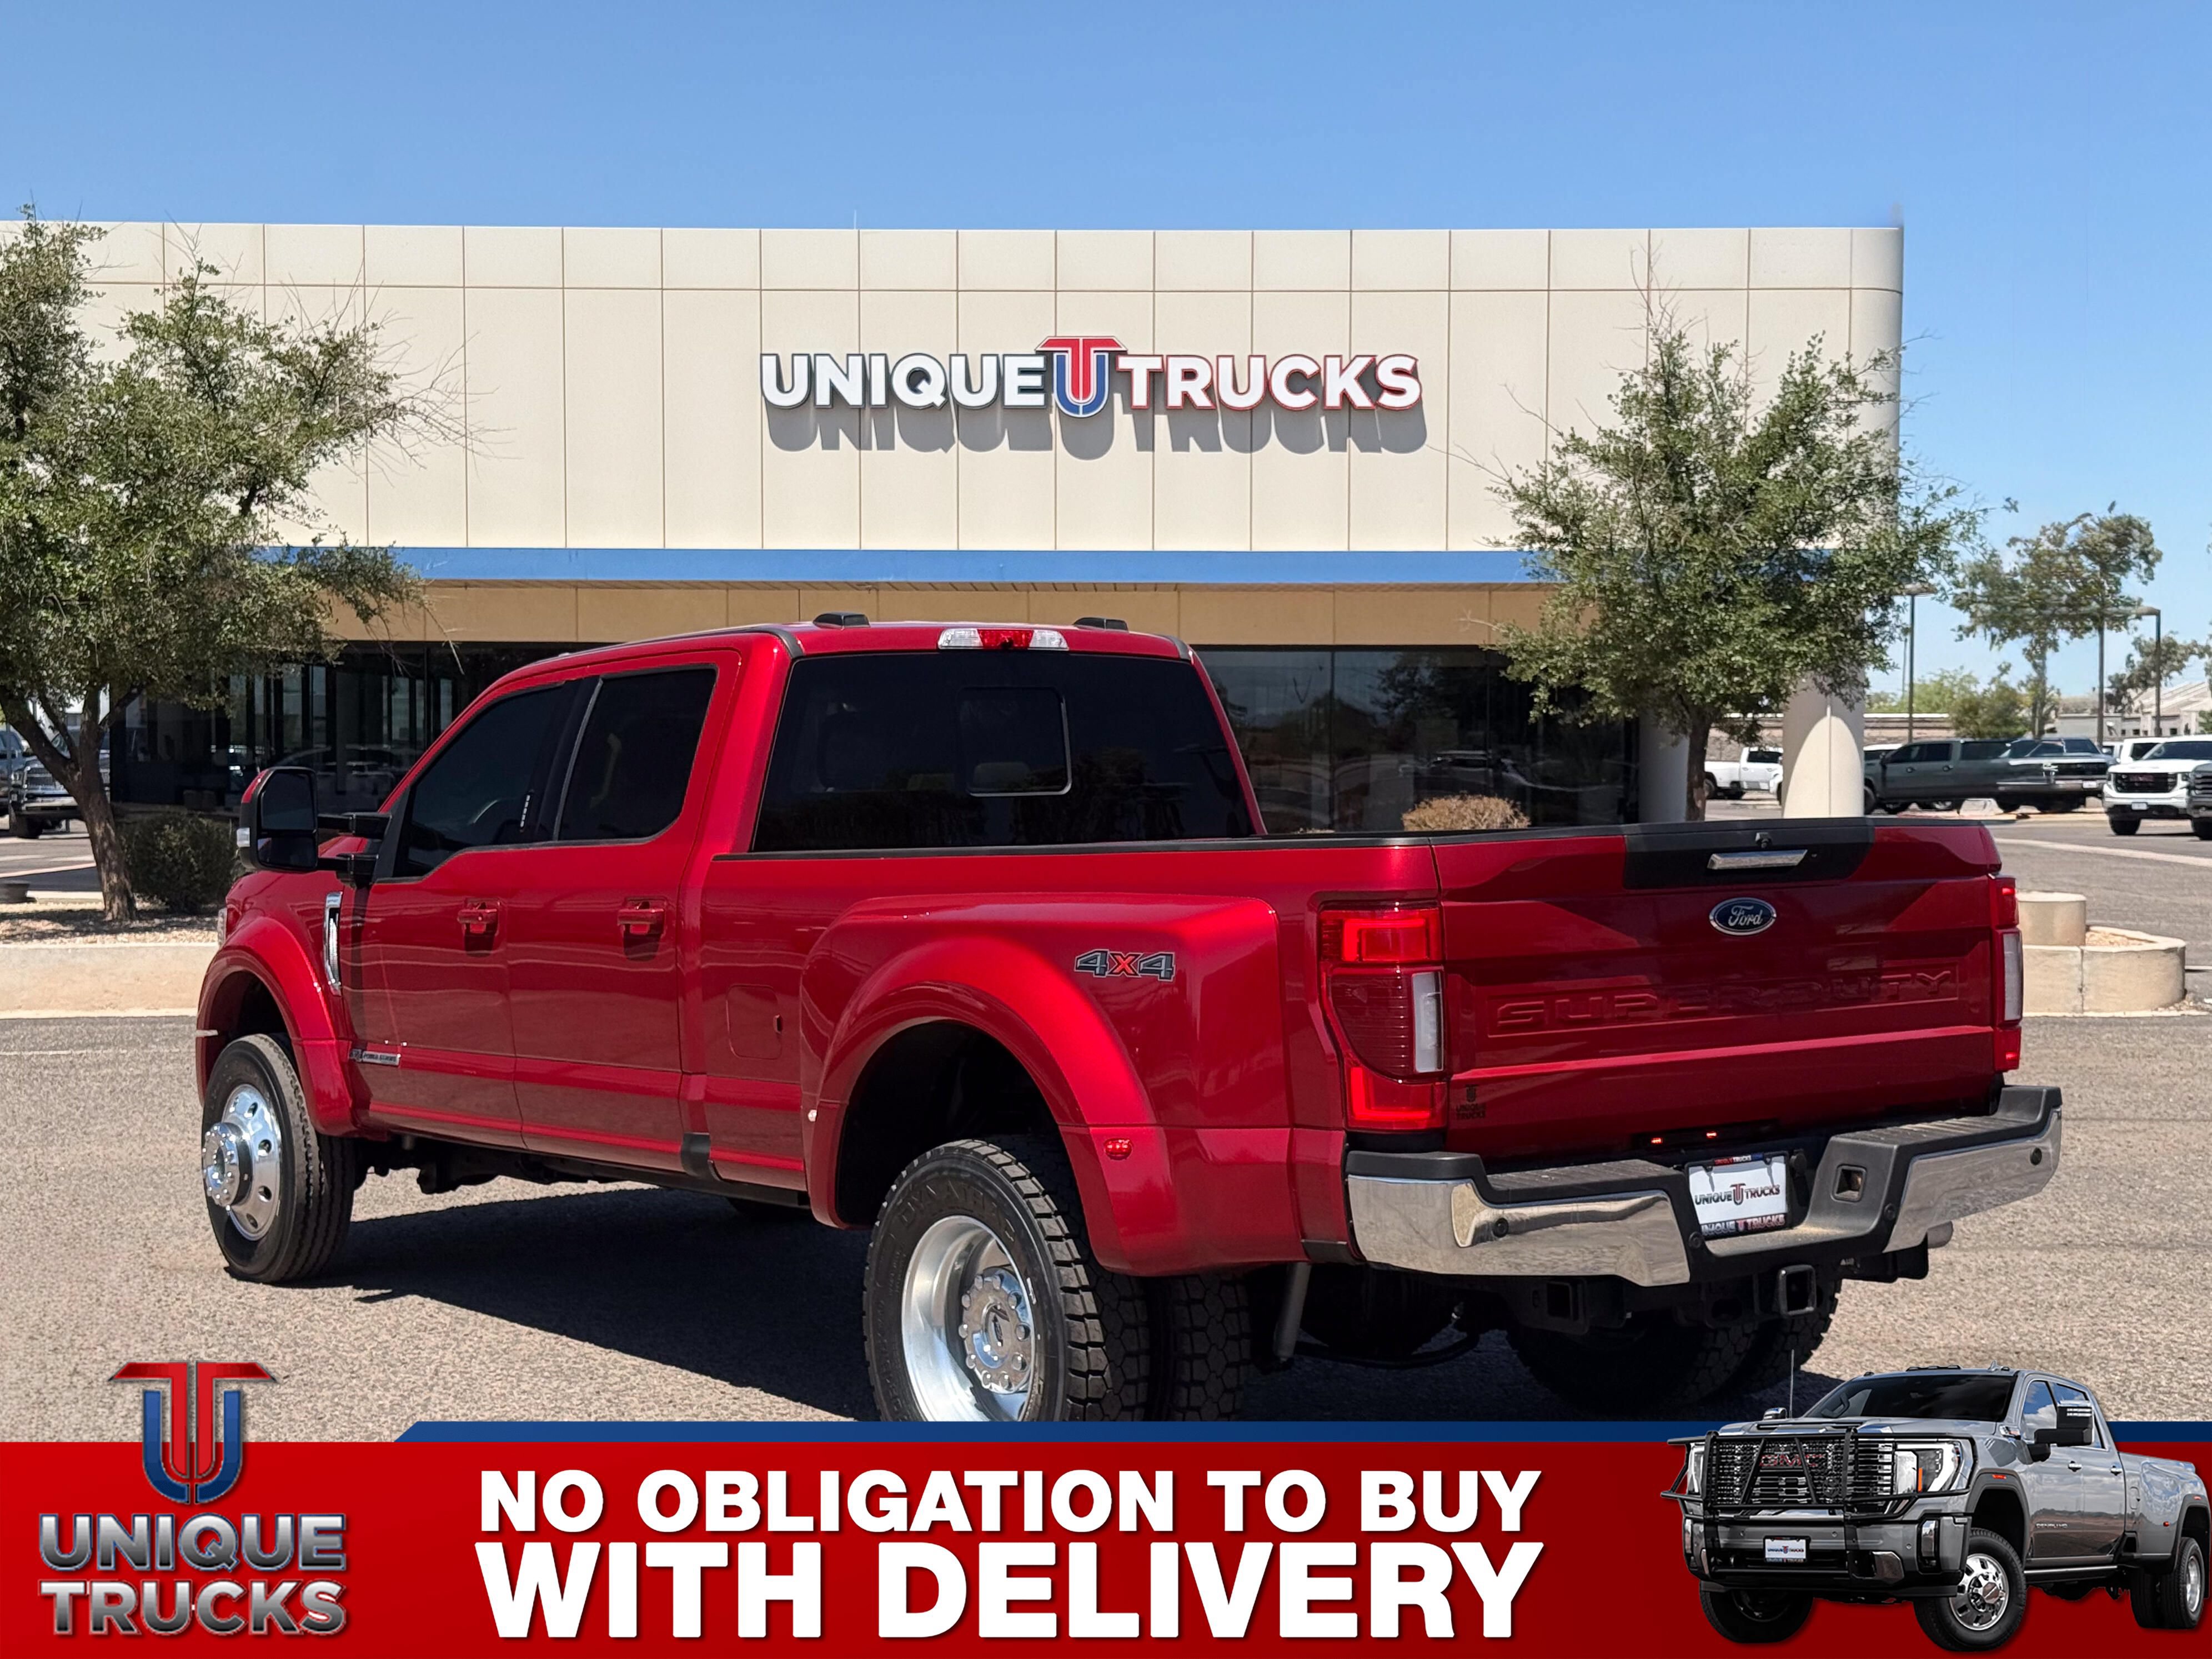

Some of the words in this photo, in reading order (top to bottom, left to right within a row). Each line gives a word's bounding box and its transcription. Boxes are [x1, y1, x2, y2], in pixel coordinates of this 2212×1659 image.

[760, 353, 1046, 410] UNIQUE
[1116, 354, 1422, 411] TRUCKS
[1728, 905, 1763, 926] Ford
[1497, 988, 1759, 1027] SUPER
[1780, 970, 1951, 1005] DUTY
[1694, 1190, 1732, 1205] UNIQUE
[1744, 1184, 1780, 1199] TRUCKS
